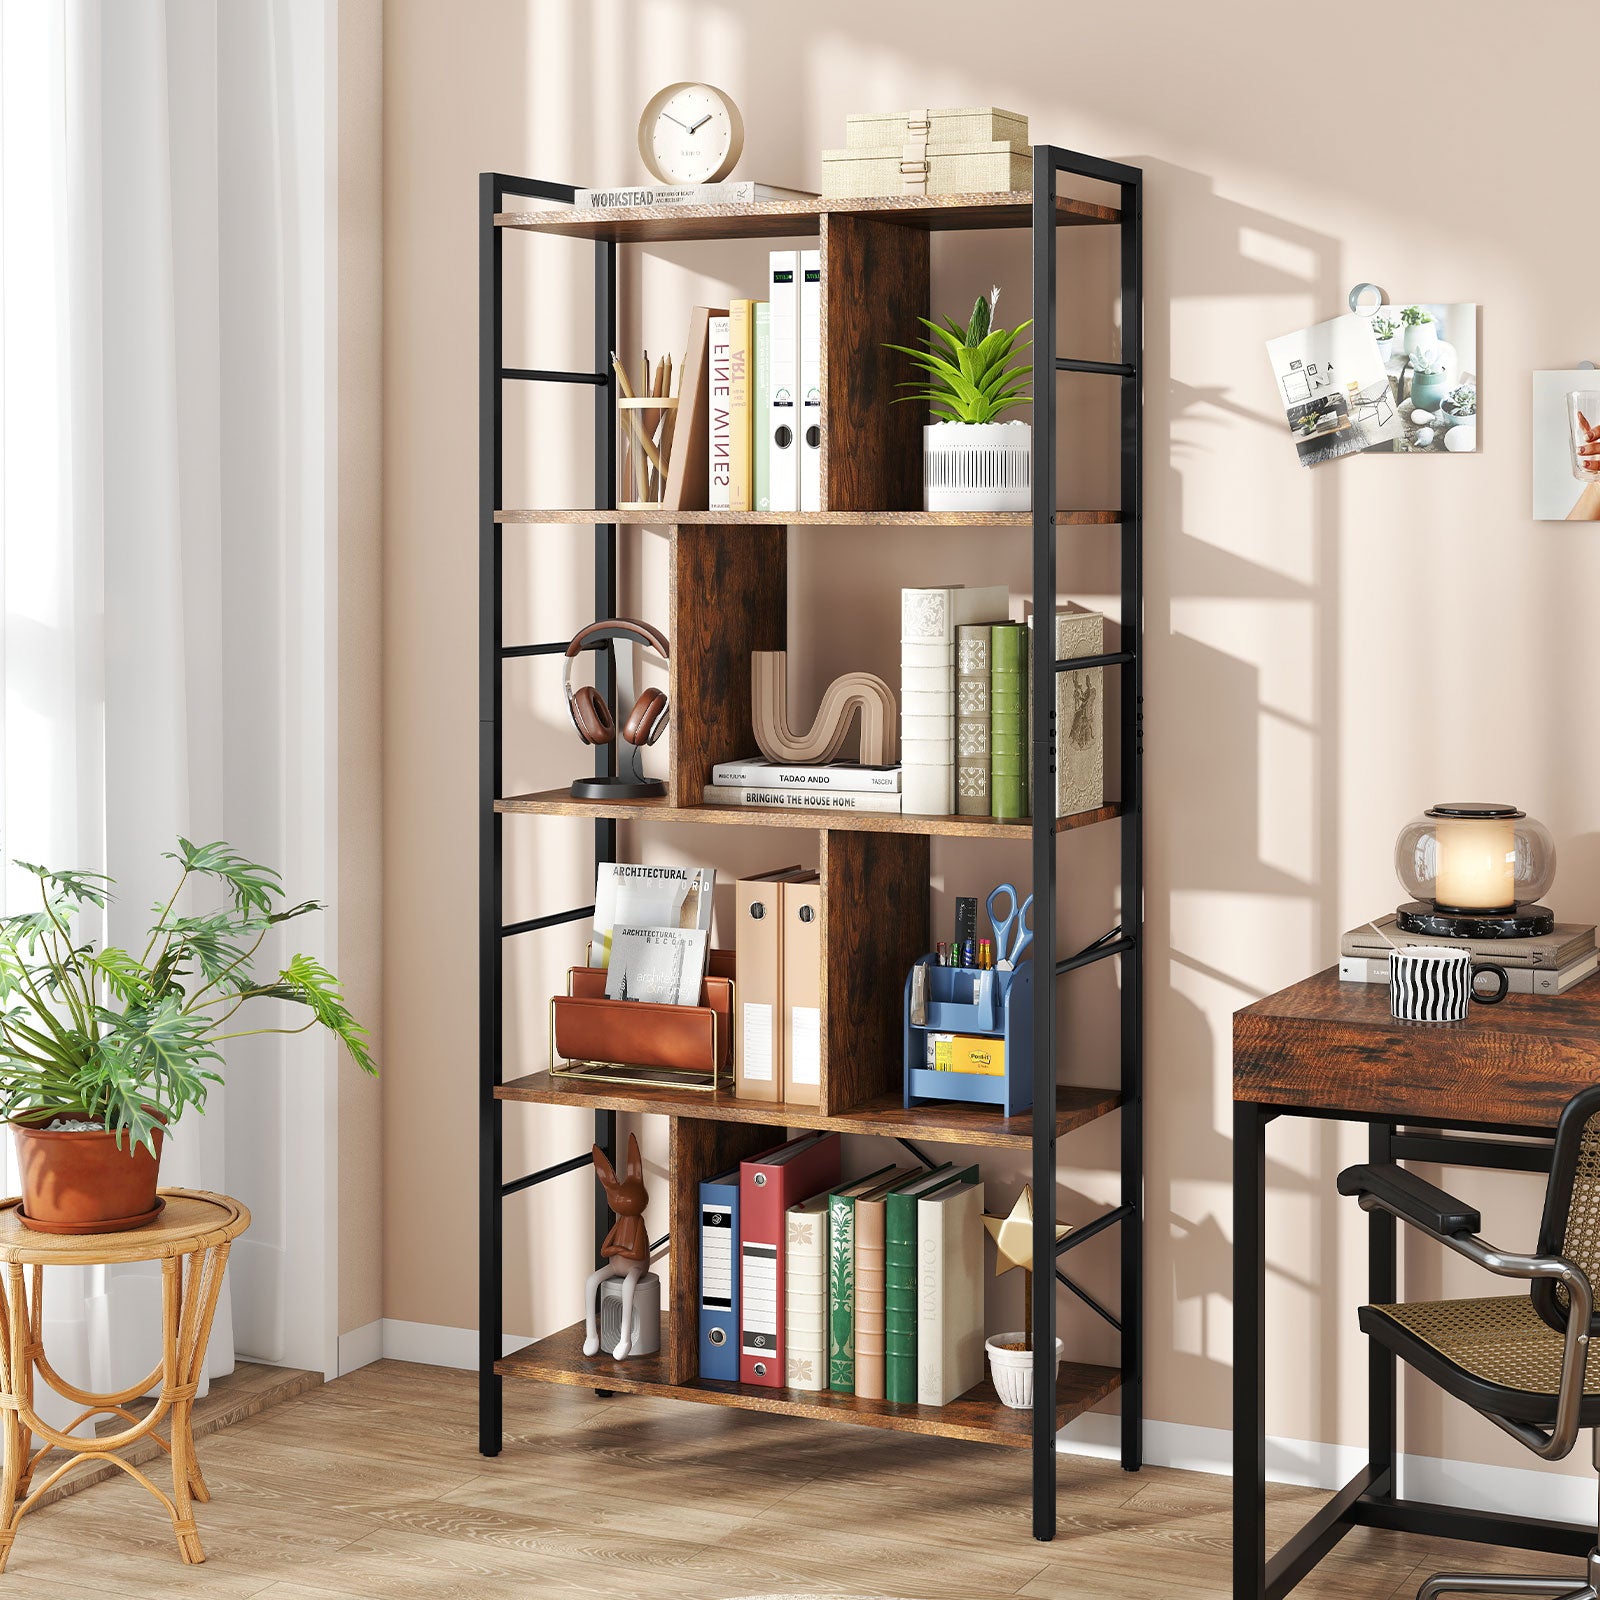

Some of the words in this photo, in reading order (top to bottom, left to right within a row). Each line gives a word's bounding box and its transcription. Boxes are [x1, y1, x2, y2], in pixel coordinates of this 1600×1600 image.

[591, 190, 654, 208] WORKSTEAD
[780, 774, 806, 783] TADAO
[808, 776, 830, 784] ANDO
[746, 792, 784, 804] BRINGING
[786, 794, 802, 804] THE
[804, 796, 830, 806] HOUSE
[832, 797, 856, 807] HOME
[613, 866, 688, 880] ARCHITECTURAL
[622, 929, 677, 938] ARCHITECTURAL
[646, 938, 693, 946] RECORD
[1532, 951, 1543, 965] VI
